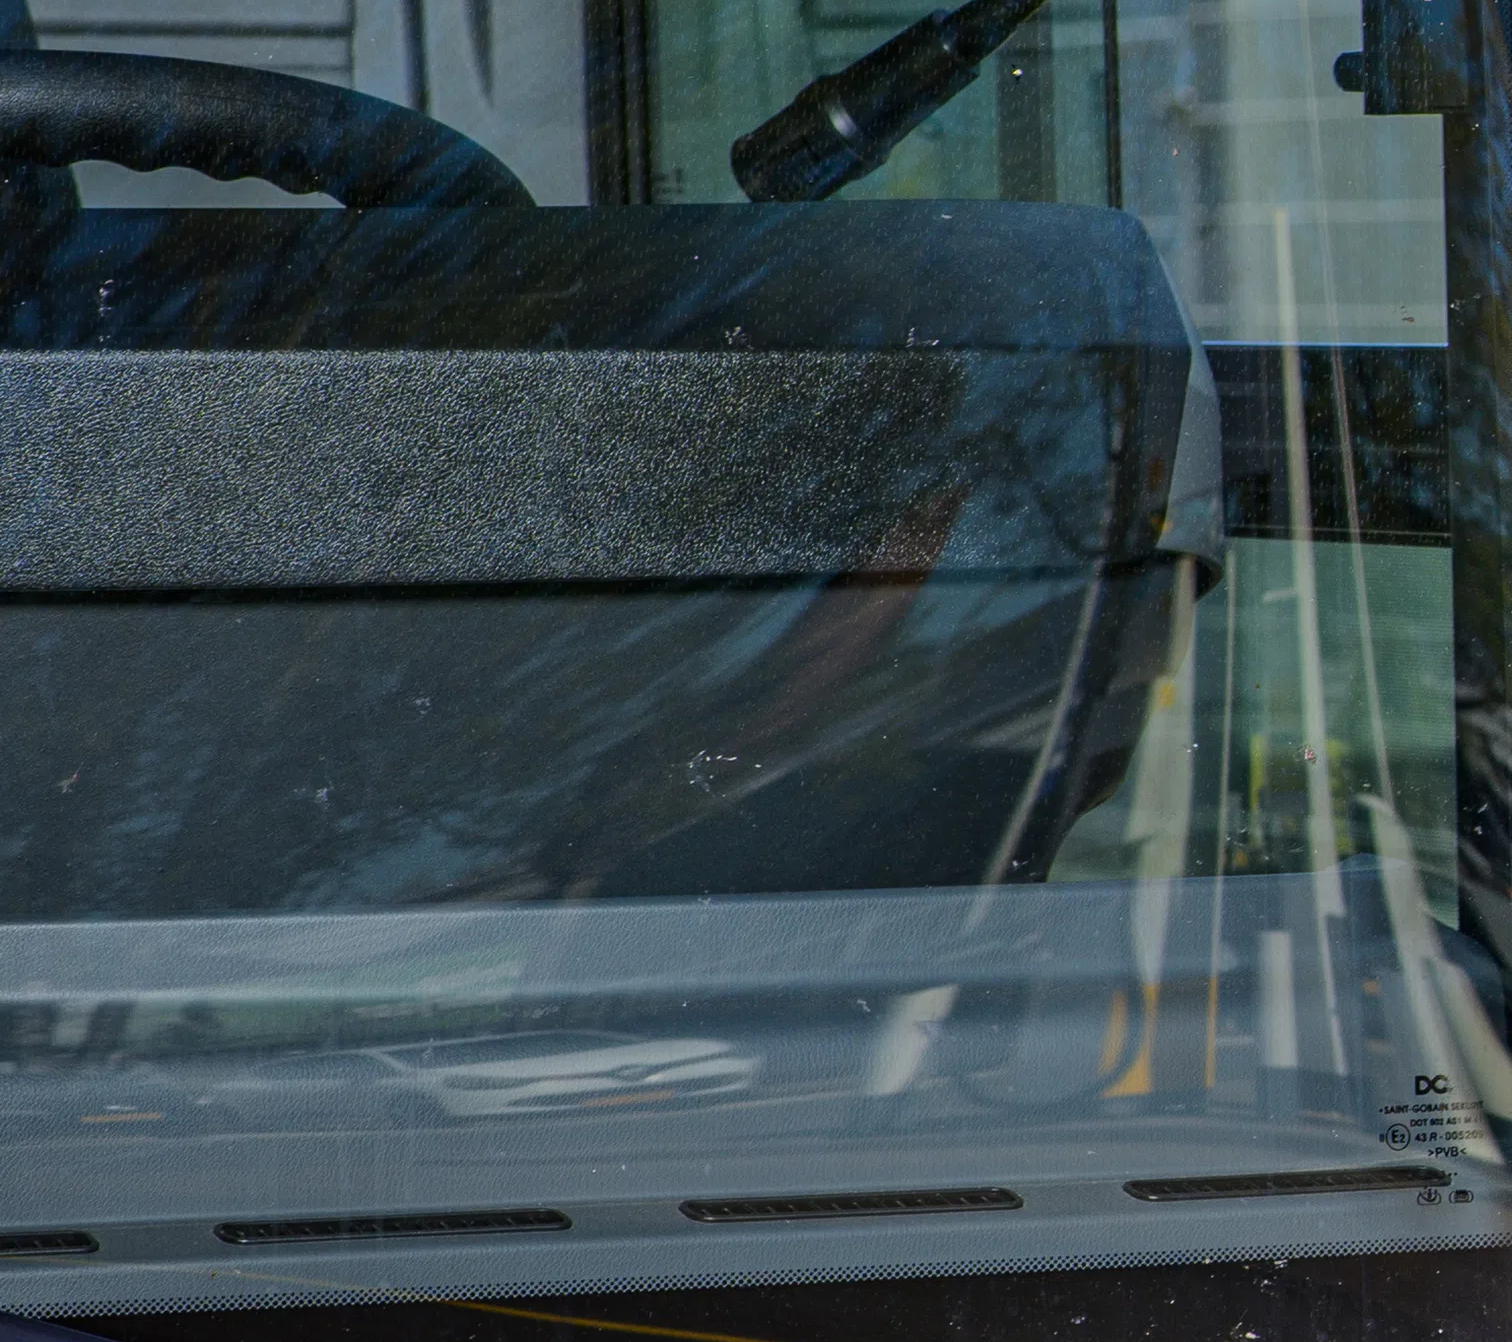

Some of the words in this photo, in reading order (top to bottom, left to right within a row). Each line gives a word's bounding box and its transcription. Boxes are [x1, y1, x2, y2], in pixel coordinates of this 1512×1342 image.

[1415, 1074, 1449, 1095] DC
[1383, 1102, 1449, 1115] SAINT-GOBAIN
[1410, 1118, 1427, 1127] DOT
